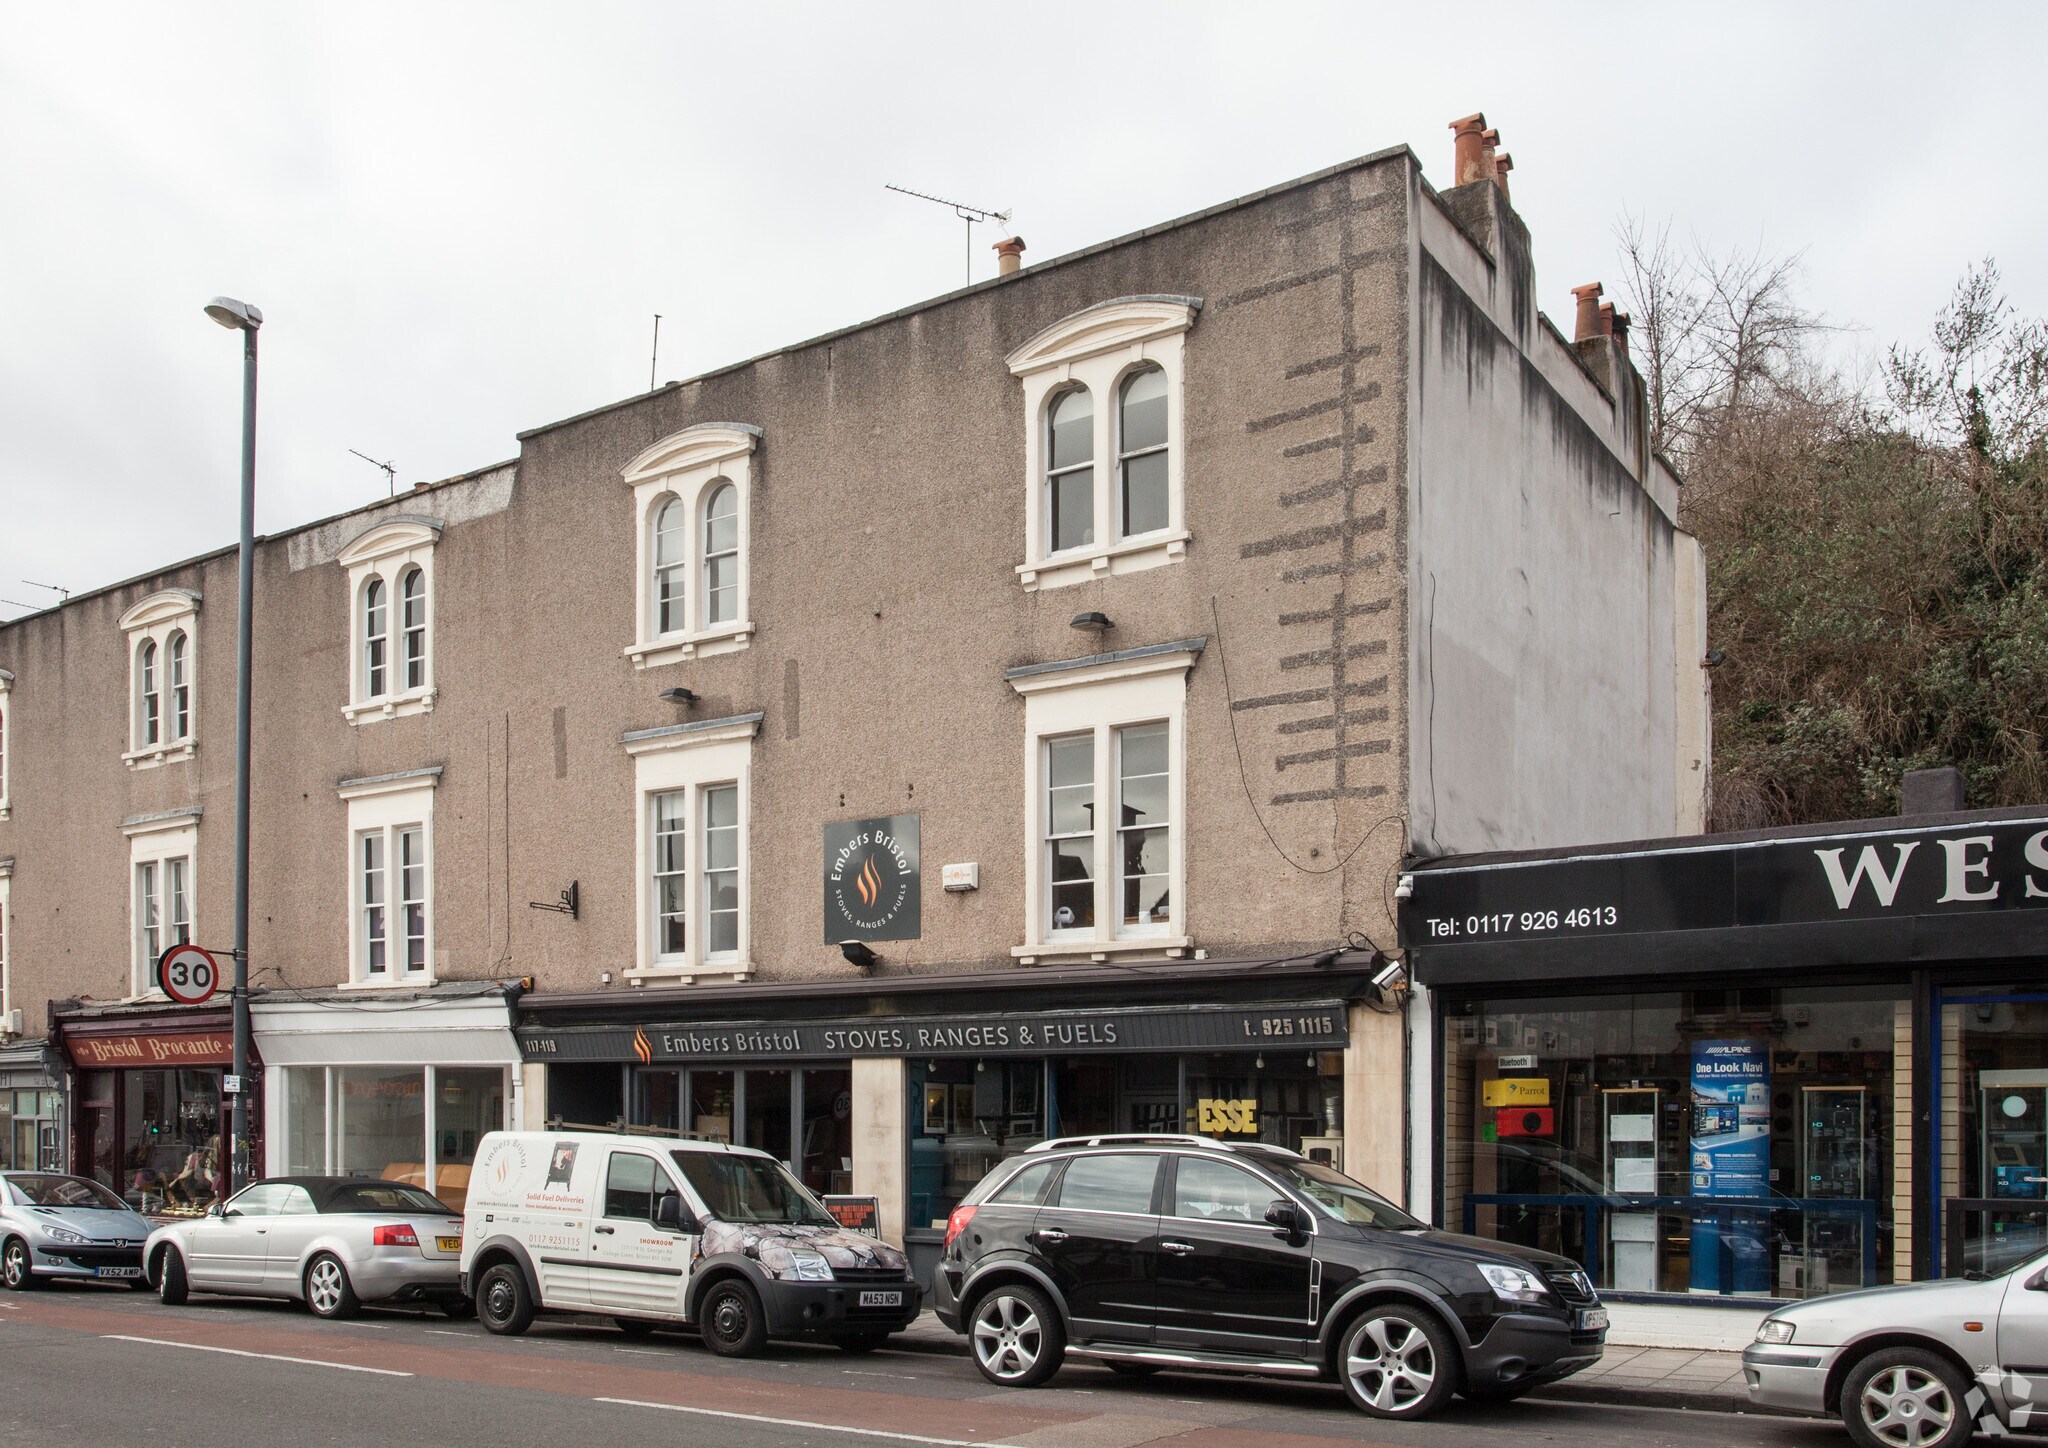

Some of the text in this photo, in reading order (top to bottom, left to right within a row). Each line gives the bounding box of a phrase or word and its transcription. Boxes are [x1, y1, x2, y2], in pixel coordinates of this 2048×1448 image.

[831, 830, 912, 881] Embers Bristol
[836, 889, 853, 924] STOVES,
[856, 918, 886, 929] RANGES
[893, 884, 906, 912] FUELS
[1426, 906, 1617, 936] Tel: 0117 926 4613
[172, 962, 210, 988] 30
[1262, 1018, 1294, 1036] 925
[1299, 1017, 1333, 1034] 1115
[664, 1032, 730, 1052] Embers
[736, 1030, 800, 1051] Bristol
[824, 1030, 911, 1050] STOVES,
[918, 1026, 1010, 1047] RANGES
[1019, 1025, 1034, 1045] &
[1043, 1023, 1117, 1044] FUELS
[89, 1034, 224, 1062] Bristol Brocante
[1713, 1046, 1752, 1054] ALPINE
[1499, 1056, 1528, 1067] Bluetooth
[1696, 1062, 1762, 1073] One Look Navi
[1520, 1086, 1545, 1096] Parrot
[1198, 1098, 1258, 1134] ESSE
[484, 1139, 528, 1168] Embers Bristol
[542, 1194, 554, 1202] Fuel
[556, 1195, 584, 1204] Deliveries
[528, 1234, 580, 1246] 0117 9251115
[100, 1268, 121, 1276] VX52
[862, 1293, 899, 1304] MA53 NSN
